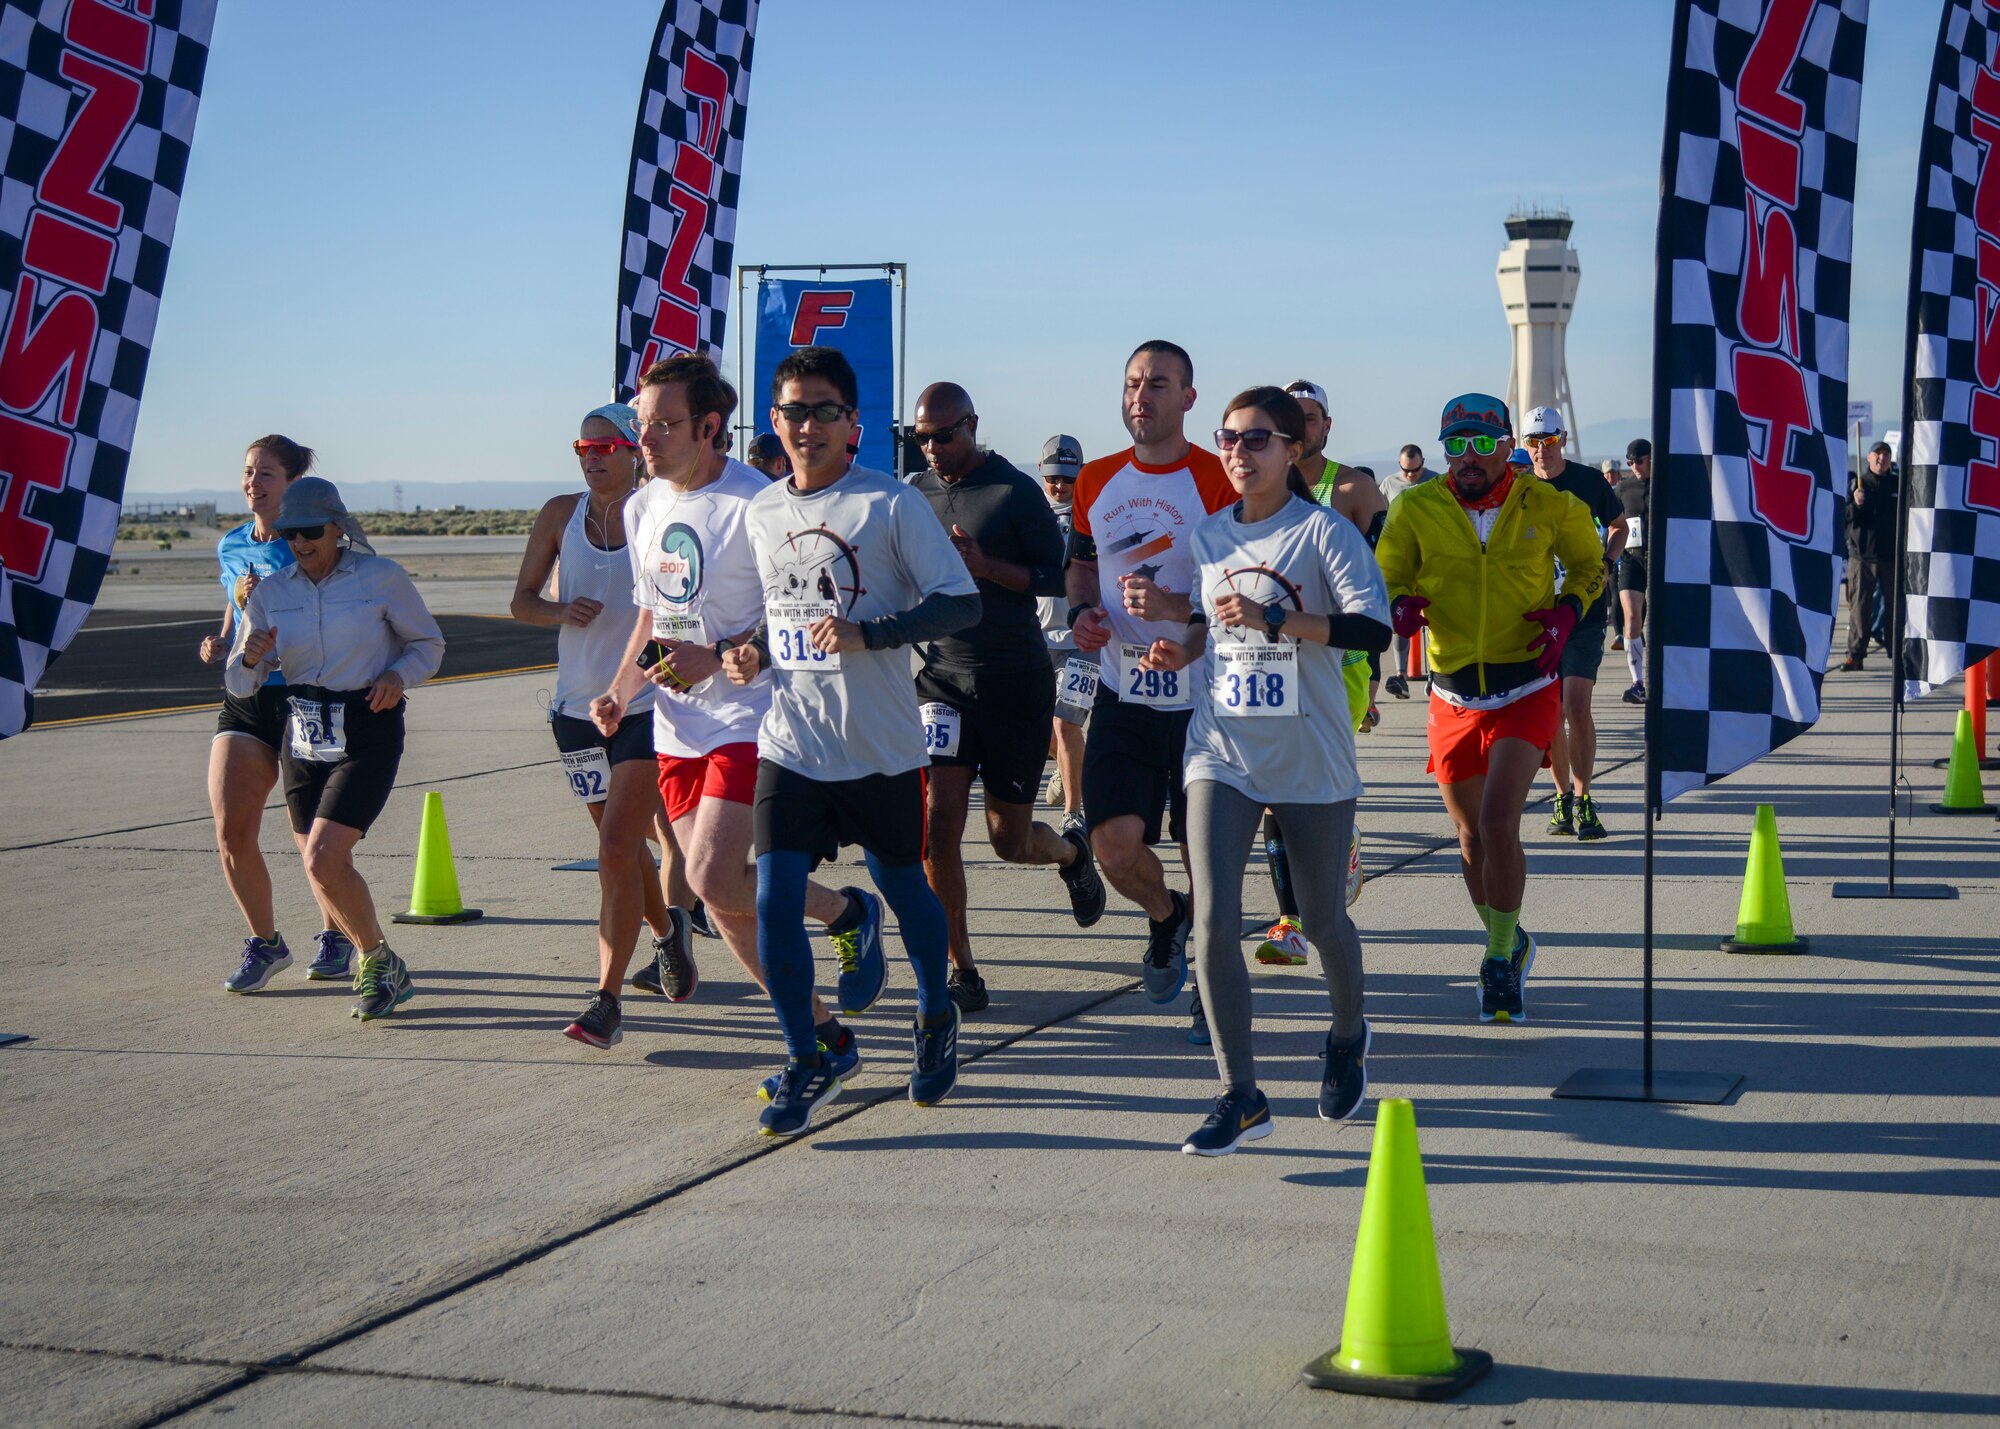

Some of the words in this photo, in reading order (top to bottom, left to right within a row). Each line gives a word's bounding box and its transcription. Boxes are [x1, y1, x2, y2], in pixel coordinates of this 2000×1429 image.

[0, 0, 156, 583] INISH
[1103, 503, 1125, 523] Run
[1127, 497, 1152, 509] With
[1155, 499, 1185, 526] History
[660, 562, 685, 573] 2017
[769, 608, 782, 617] RUN
[784, 608, 801, 617] WITH
[803, 608, 833, 617] HISTORY
[656, 622, 670, 630] WITH
[672, 620, 701, 630] HISTORY
[1123, 649, 1136, 658] RUN
[1219, 652, 1233, 661] RUN
[1235, 651, 1255, 661] WITH
[1257, 651, 1293, 661] HISTORY
[1067, 673, 1096, 696] 289
[1130, 668, 1178, 697] 298
[1226, 673, 1284, 707] 318
[931, 708, 958, 718] HISTORY
[576, 751, 604, 764] HISTORY
[566, 770, 607, 797] 92
